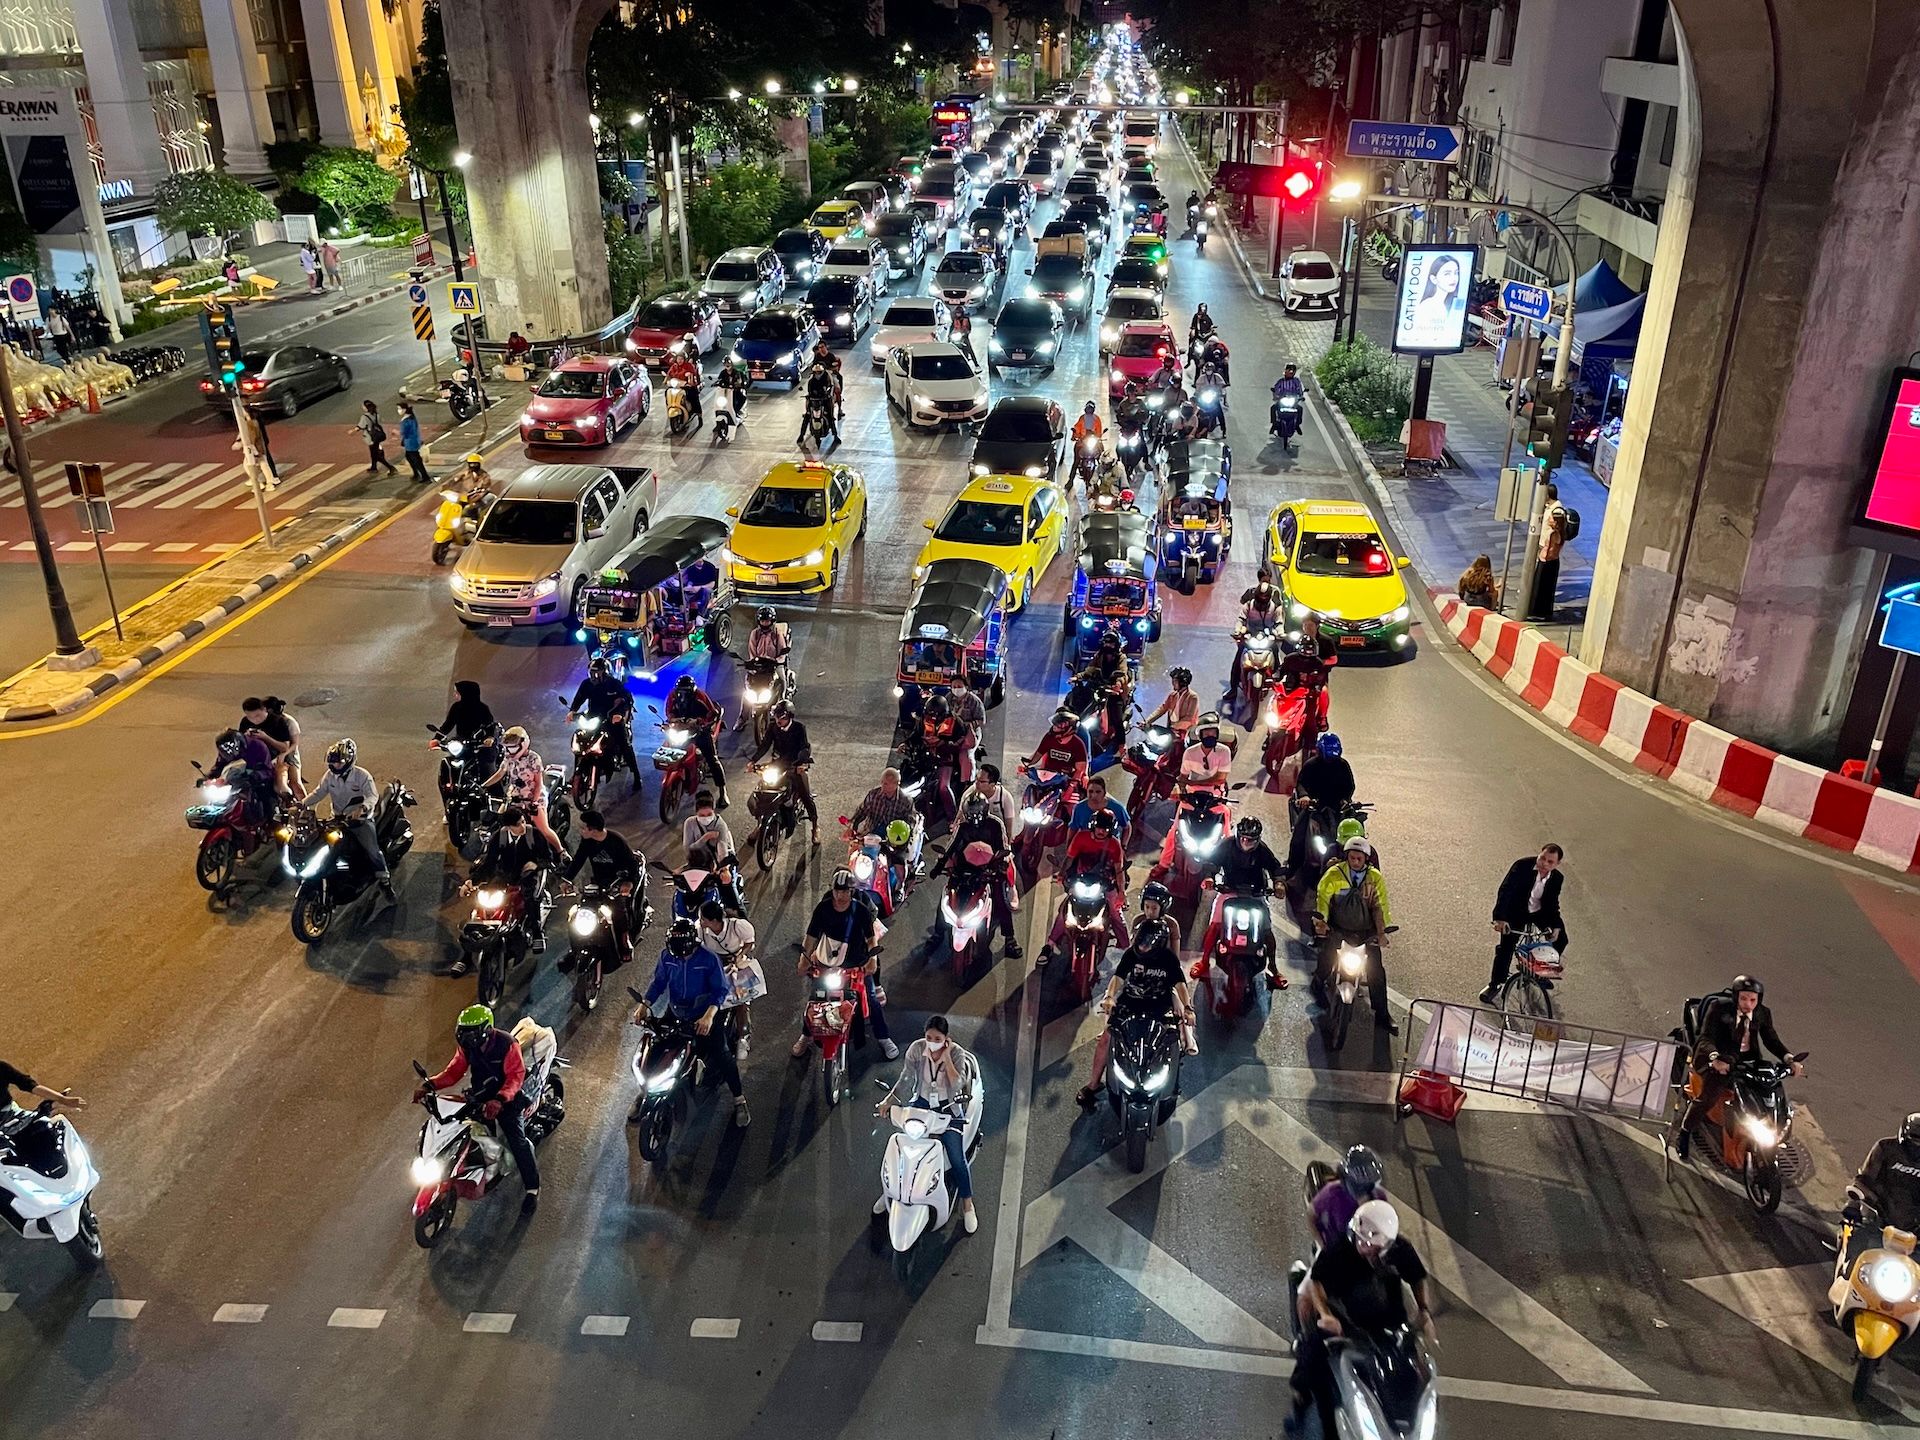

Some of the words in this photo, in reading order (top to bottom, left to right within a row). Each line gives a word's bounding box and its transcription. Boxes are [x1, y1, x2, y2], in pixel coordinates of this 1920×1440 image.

[0, 101, 58, 116] ERAWAN
[1372, 148, 1396, 156] Rama
[1409, 255, 1423, 286] DOLL
[1404, 289, 1418, 331] CATHY
